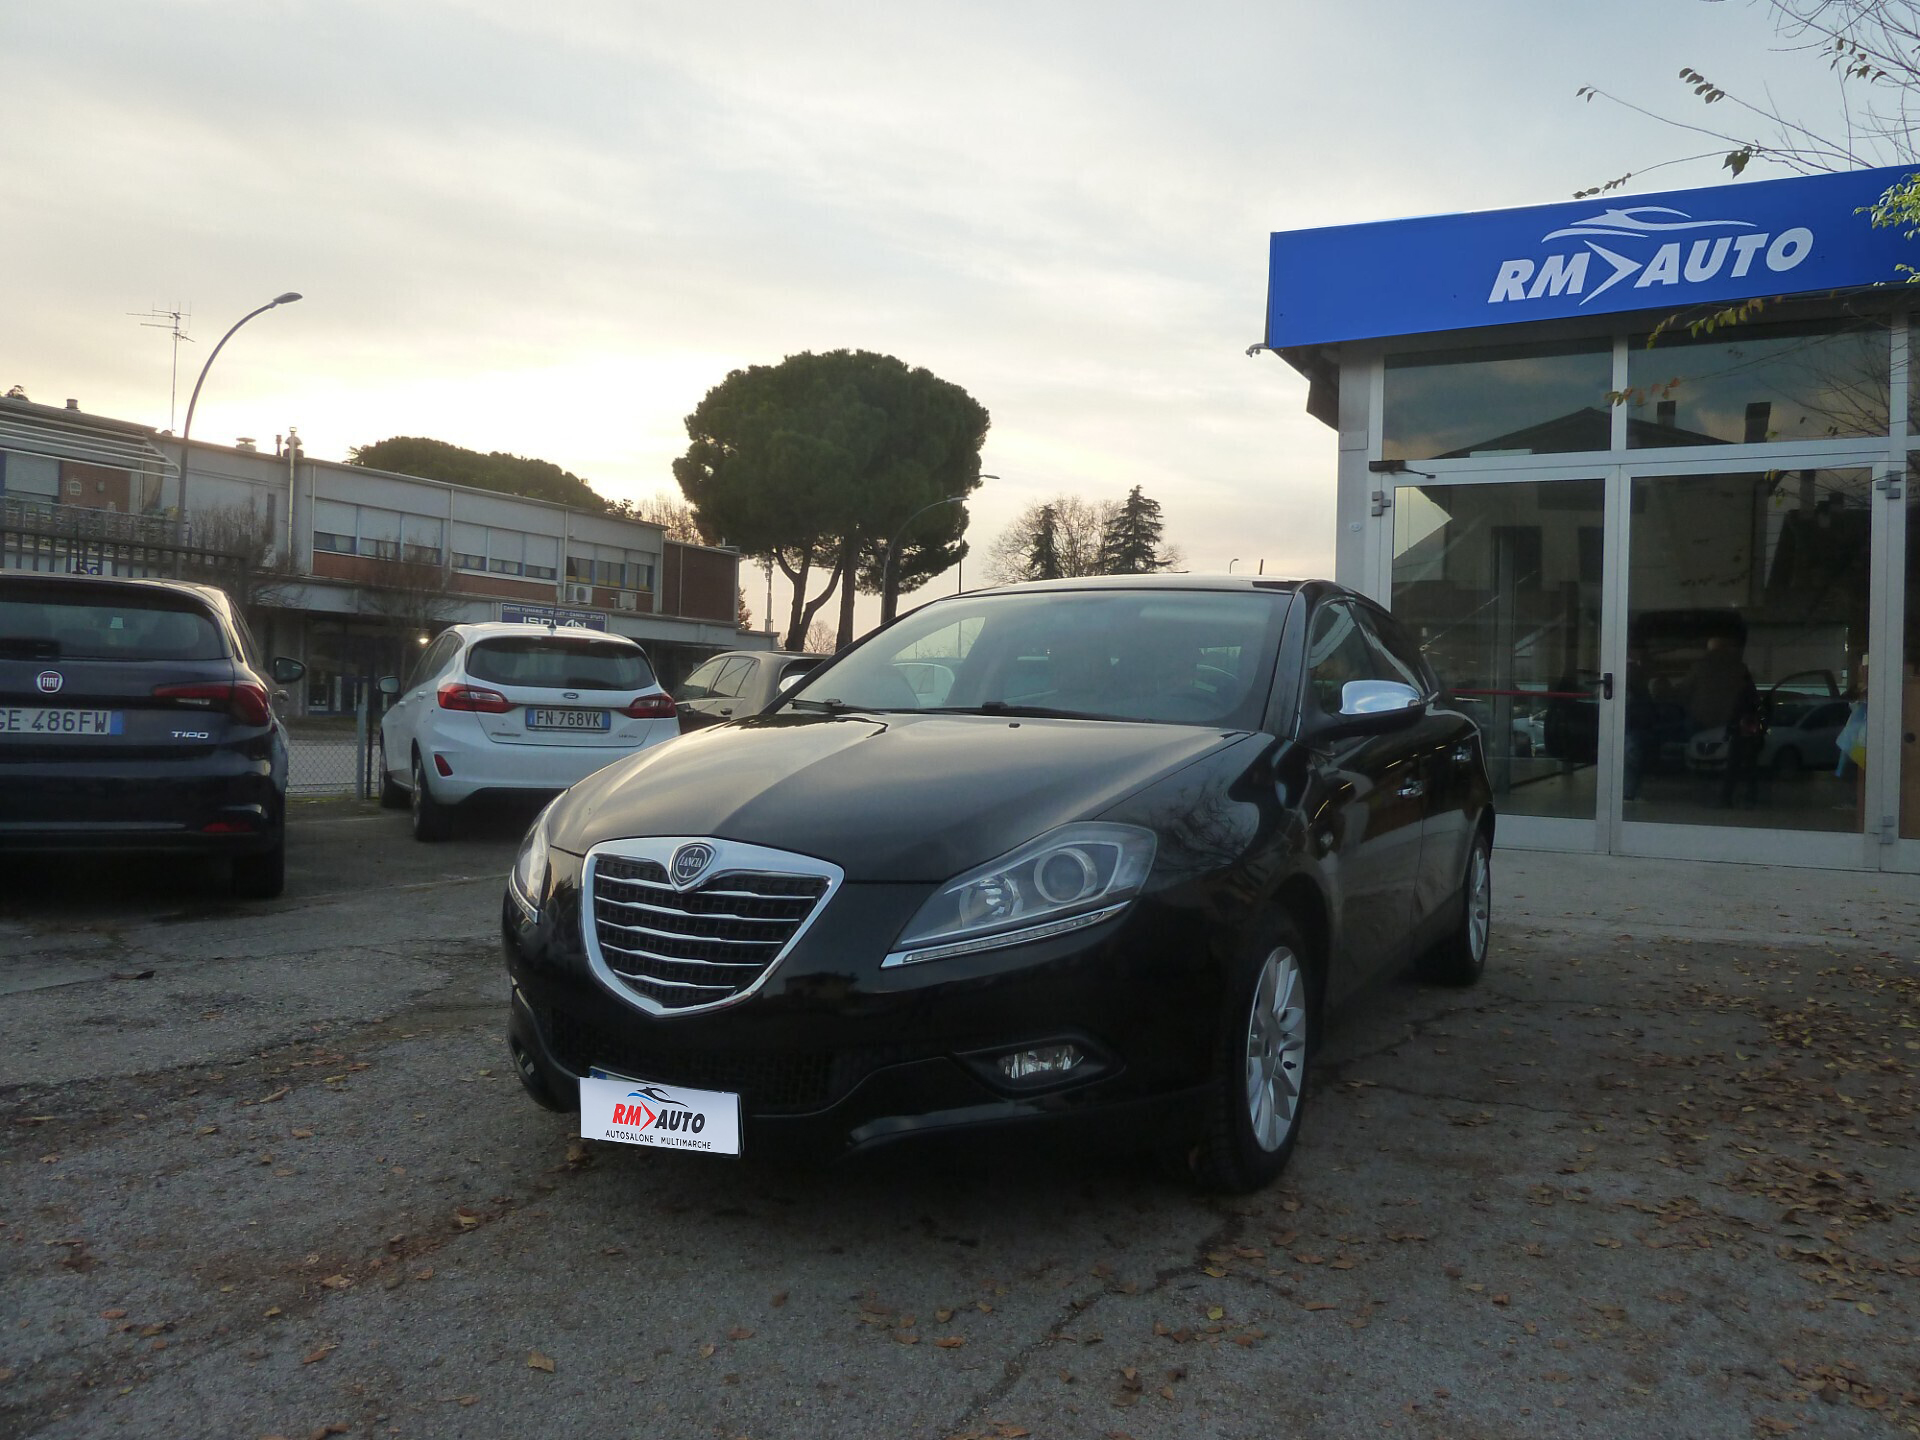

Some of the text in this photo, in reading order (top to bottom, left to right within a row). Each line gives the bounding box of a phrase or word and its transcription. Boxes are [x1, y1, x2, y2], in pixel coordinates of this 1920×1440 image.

[1488, 226, 1814, 304] RM AUTO
[42, 677, 58, 688] FIAT
[31, 710, 106, 733] 486FW
[536, 710, 601, 727] FN 768VK
[171, 730, 209, 739] TIPO
[679, 856, 702, 867] LANCIA
[612, 1103, 706, 1134] RM AUTO
[605, 1129, 711, 1149] AUTOSALONE MULTIMARCHE
